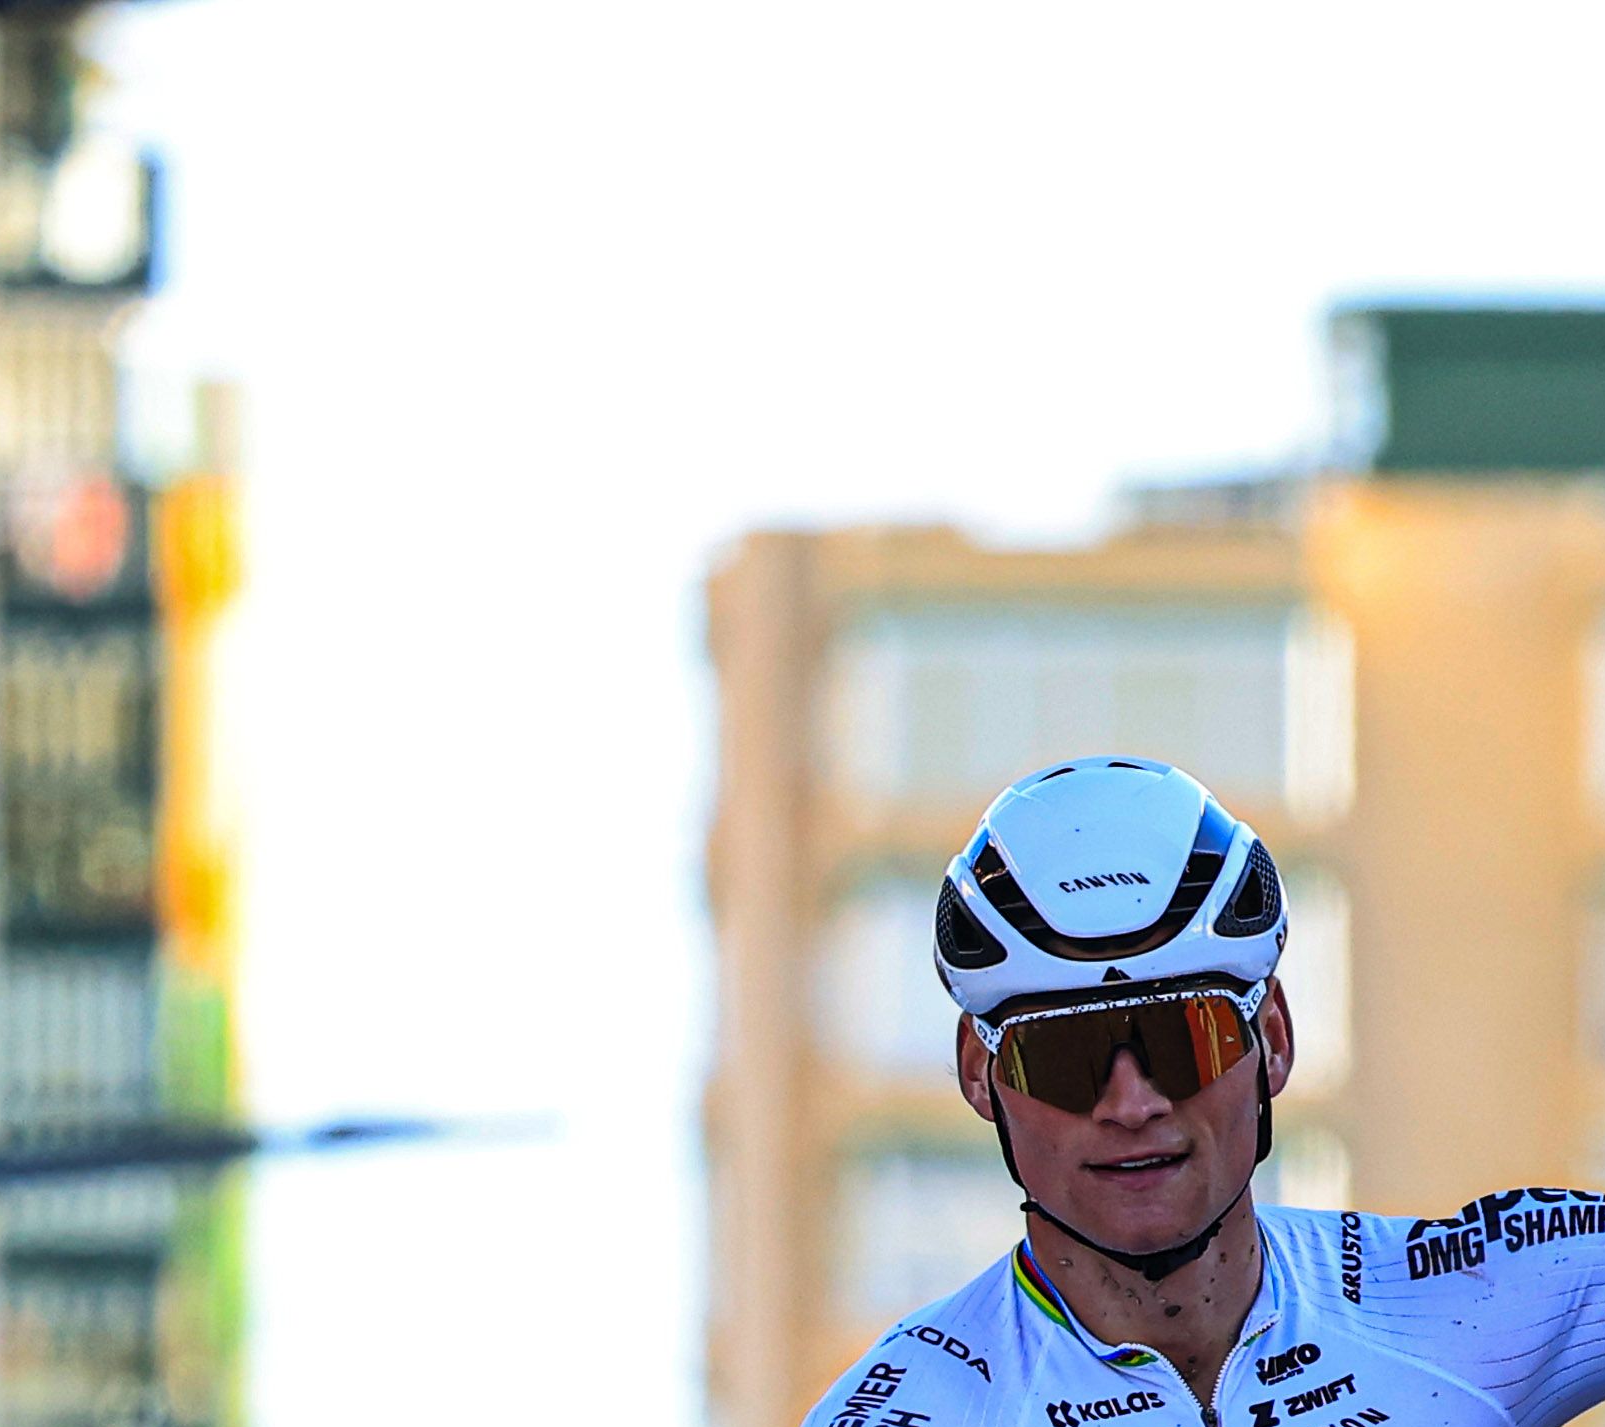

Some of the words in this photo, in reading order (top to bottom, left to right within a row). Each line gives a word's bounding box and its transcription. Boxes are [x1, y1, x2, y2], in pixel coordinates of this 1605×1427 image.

[1058, 871, 1151, 894] CANYON
[1341, 1211, 1362, 1305] BRUSTO
[1406, 1226, 1486, 1280] DMG
[1283, 1373, 1357, 1417] ZWIFT
